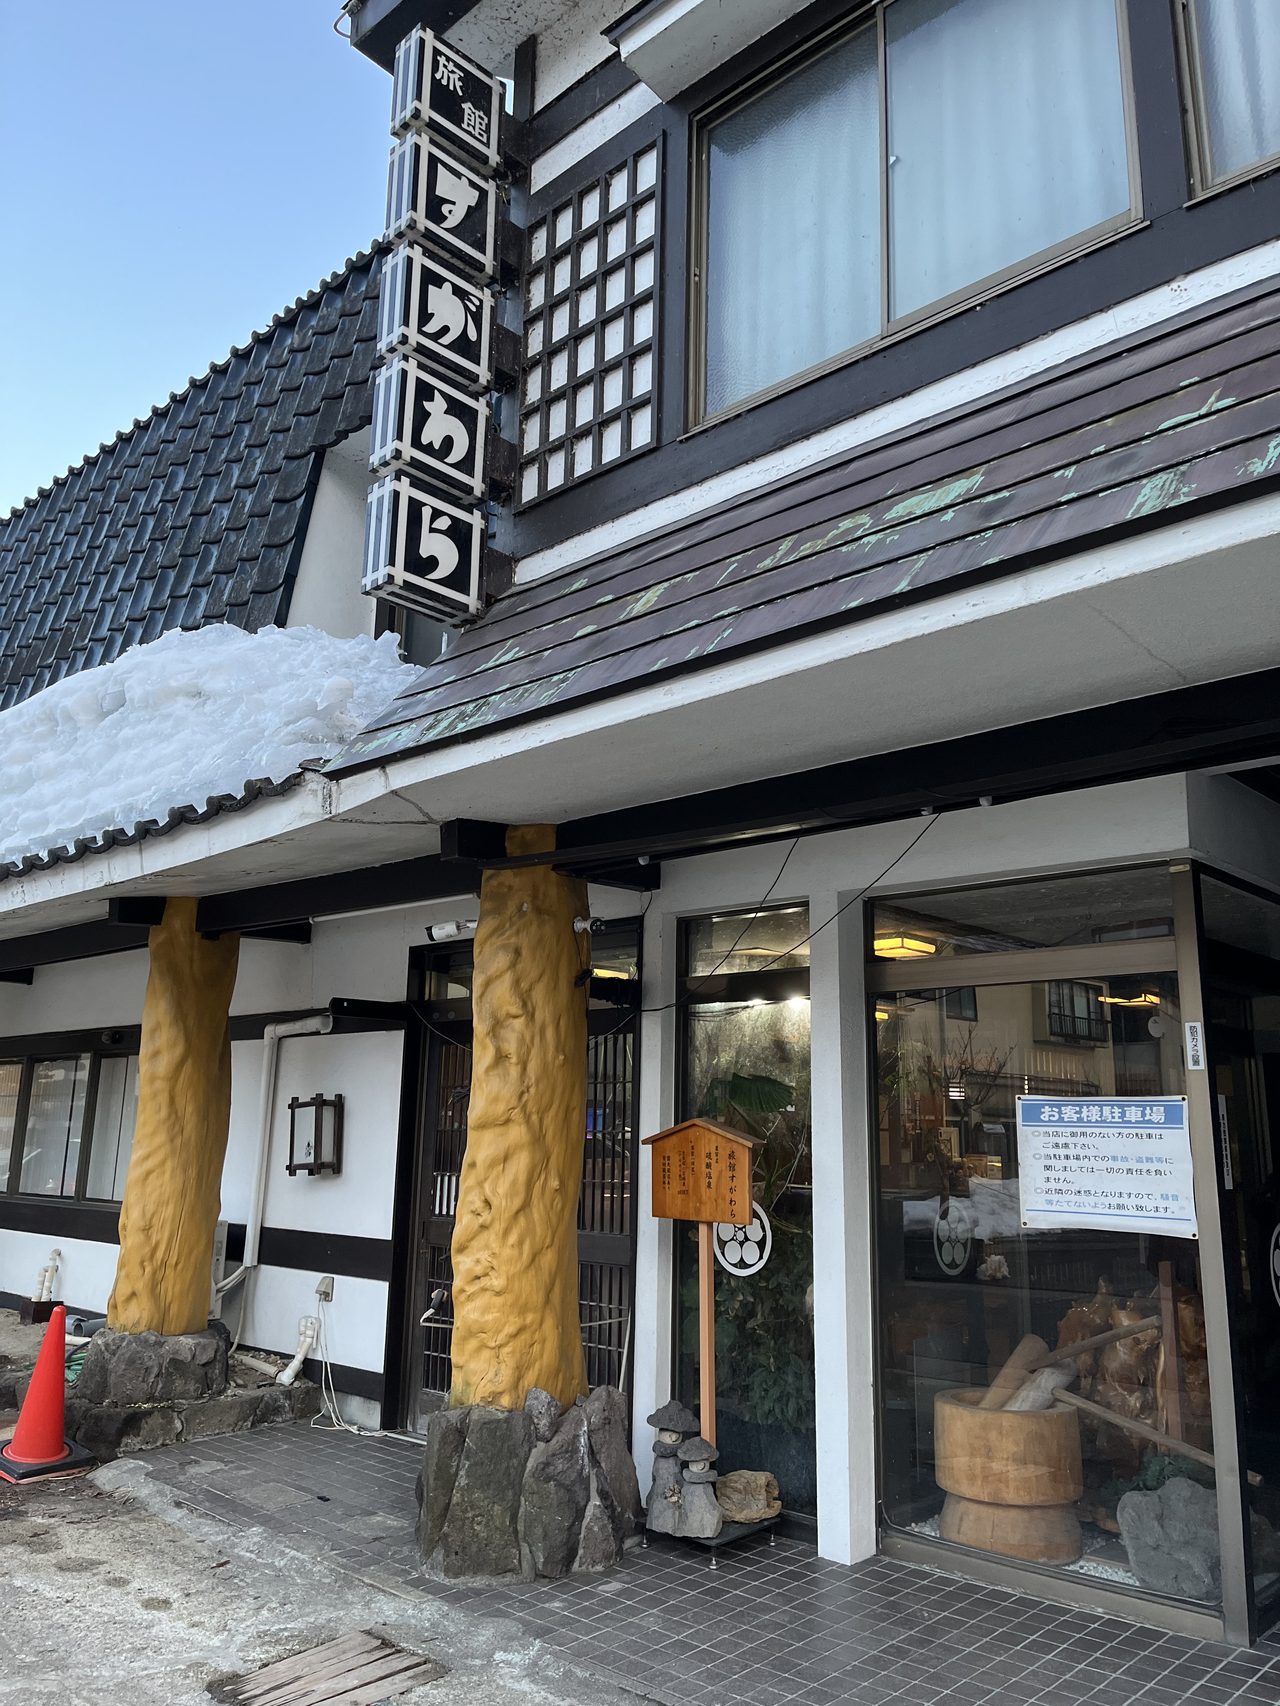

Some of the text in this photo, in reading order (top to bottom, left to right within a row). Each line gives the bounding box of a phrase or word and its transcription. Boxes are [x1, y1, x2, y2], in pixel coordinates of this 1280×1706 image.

[418, 54, 489, 580] 旅館 すがわら
[1040, 1105, 1166, 1124] お客様駐車場
[1042, 1142, 1100, 1151] ご遠慮下さい。
[1043, 1165, 1173, 1177] 関しましては一切の責任を負い
[727, 1150, 737, 1219] 旅館すがわら
[1044, 1176, 1075, 1185] ません。
